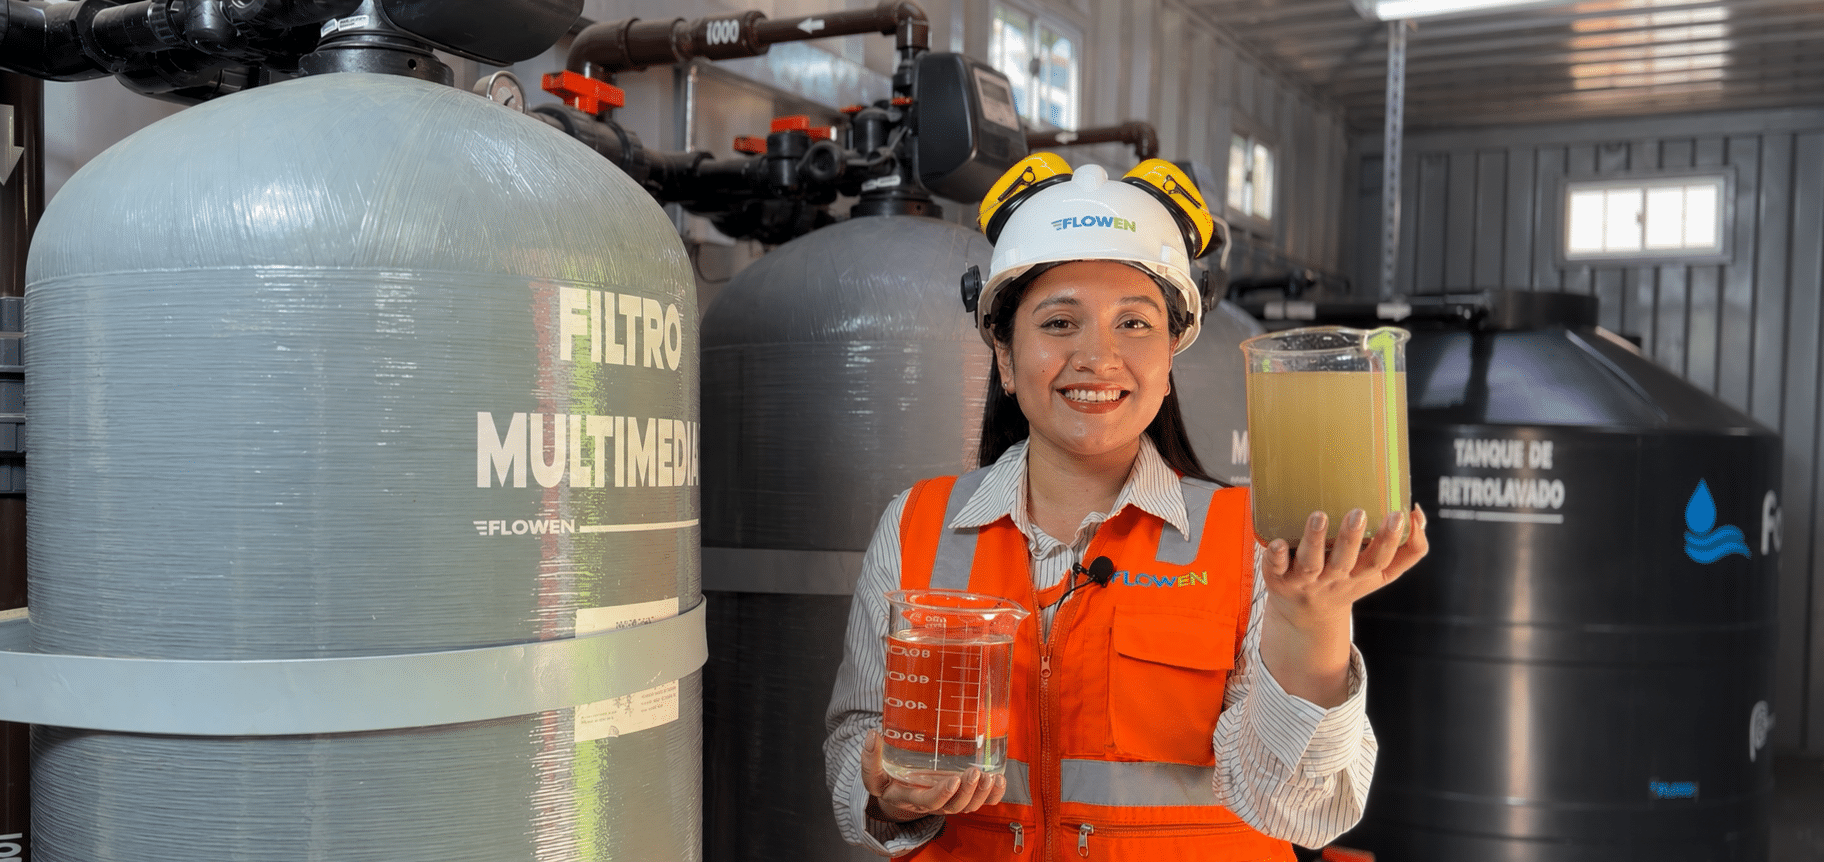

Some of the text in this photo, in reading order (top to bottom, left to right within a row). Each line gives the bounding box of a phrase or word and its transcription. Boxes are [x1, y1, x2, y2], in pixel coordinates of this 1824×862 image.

[706, 19, 740, 46] 1000
[1062, 215, 1137, 233] FLOWEN
[559, 286, 682, 372] FILTRO
[476, 411, 699, 489] MULTIMEDIA
[1453, 438, 1554, 471] TANQUE DE
[1438, 475, 1566, 510] RETROLAVADO
[488, 519, 575, 536] FLOWEN
